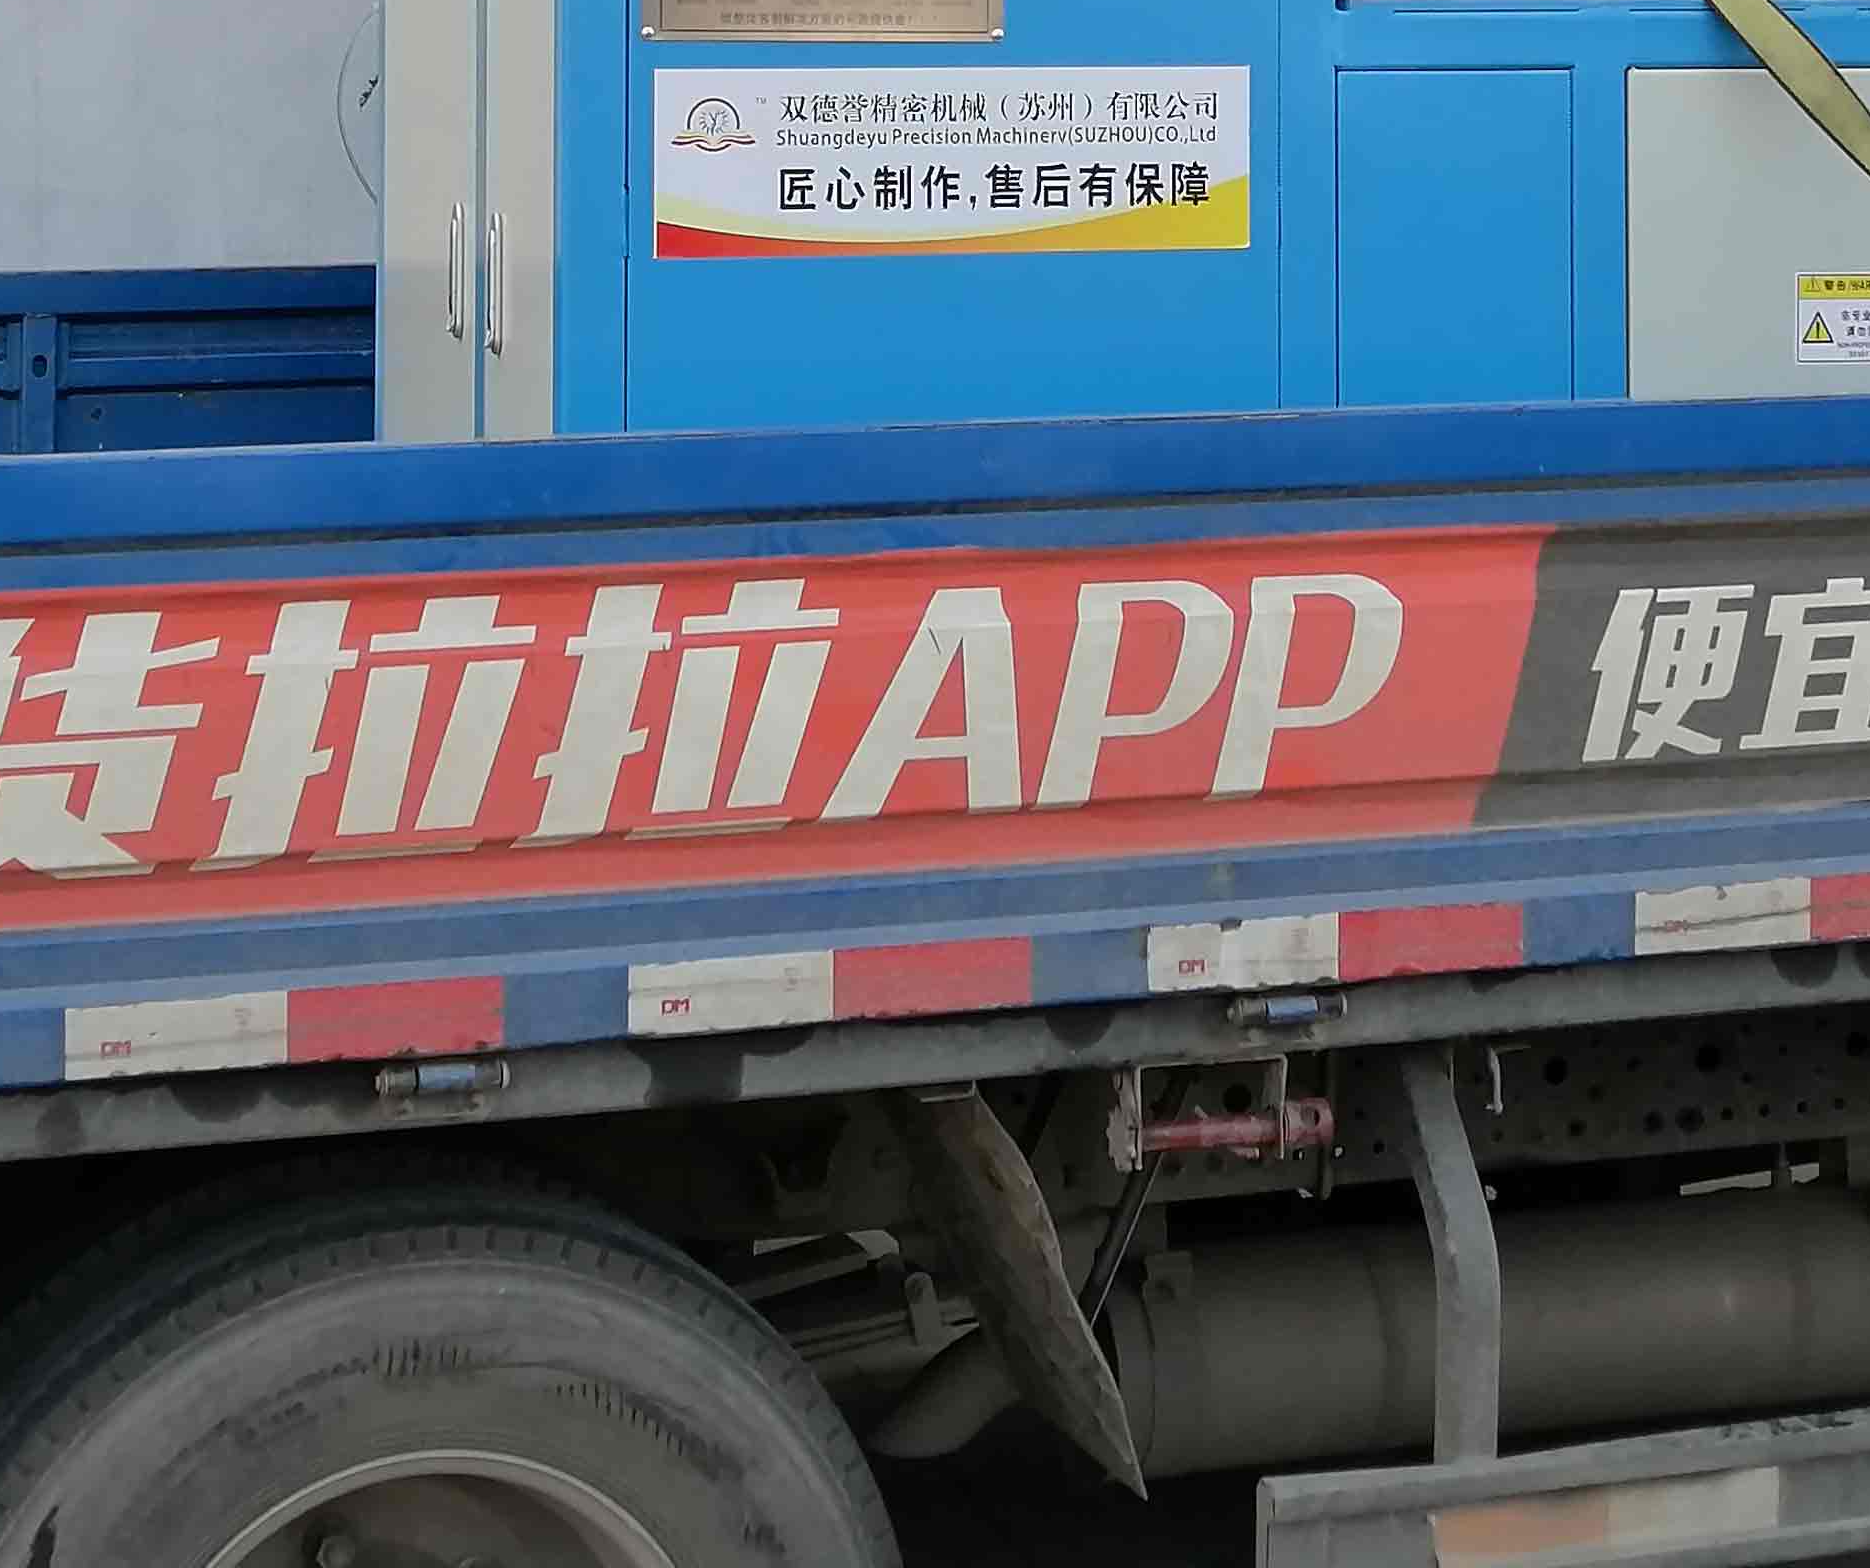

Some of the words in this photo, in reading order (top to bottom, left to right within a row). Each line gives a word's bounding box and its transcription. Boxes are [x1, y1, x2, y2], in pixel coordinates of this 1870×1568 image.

[781, 92, 1217, 123] 双德誉精密机械（苏州）有限公司
[776, 128, 887, 149] Shuangdeyu
[892, 127, 972, 145] Precision
